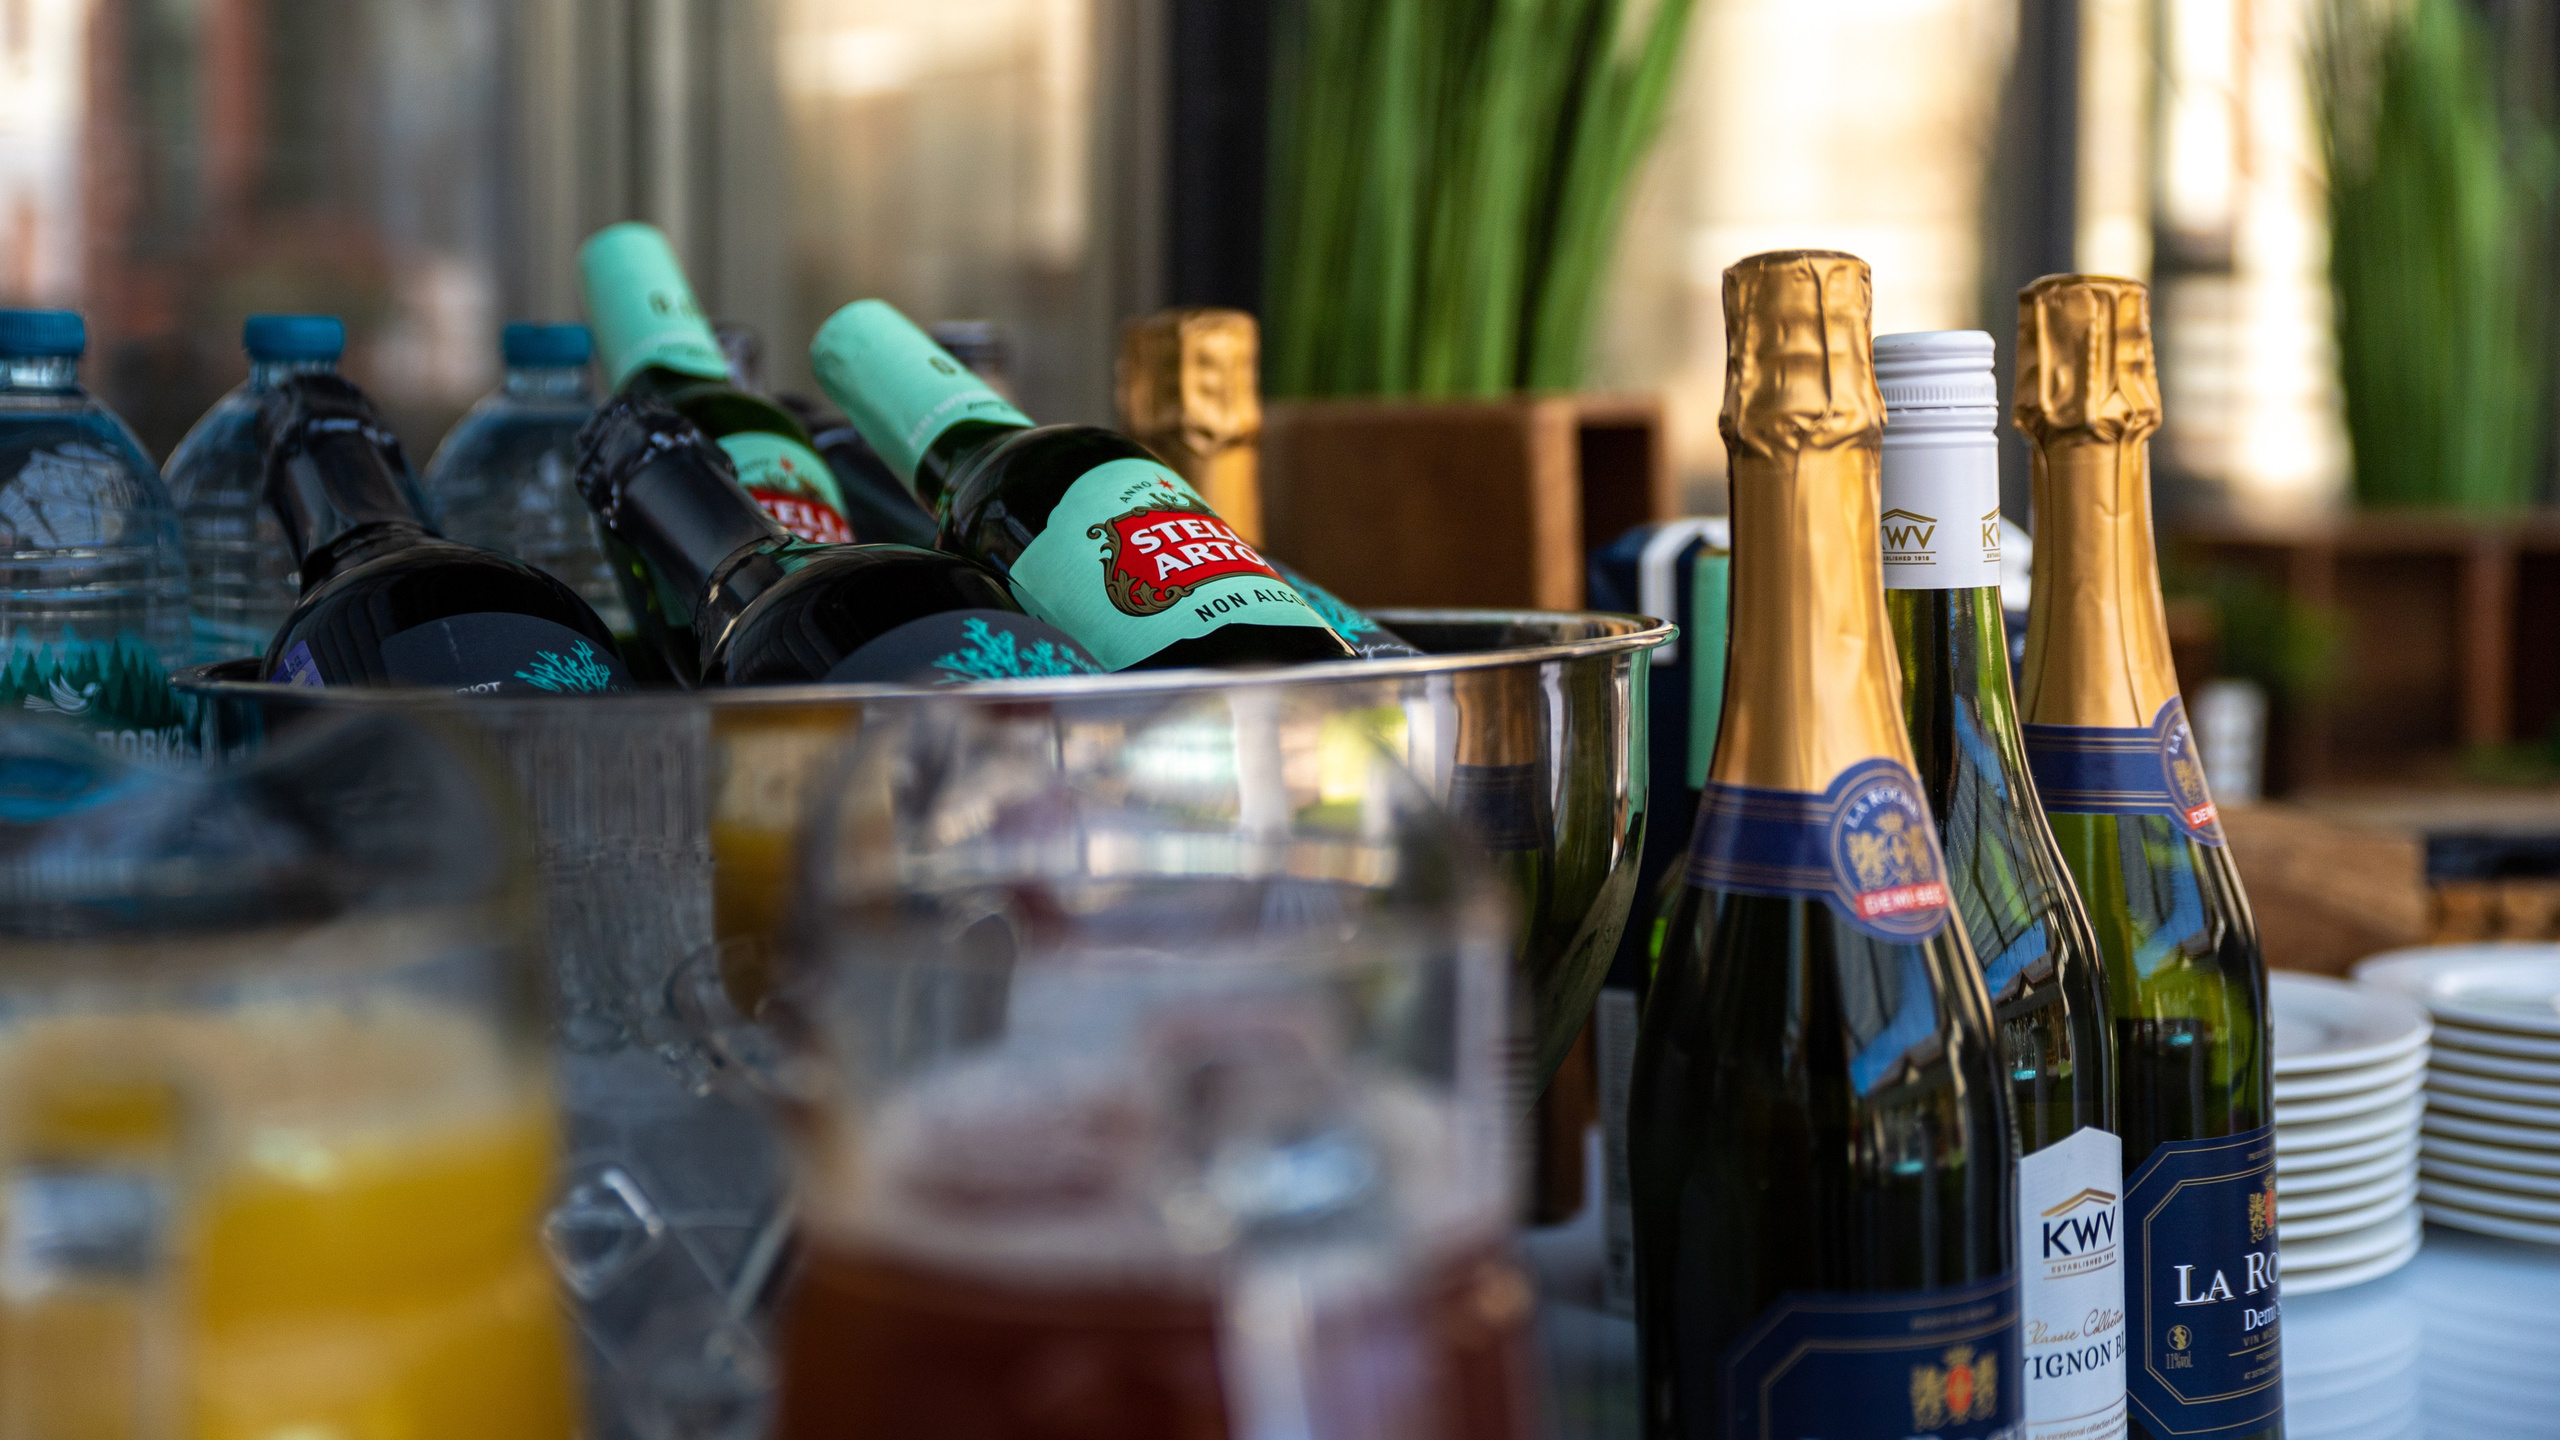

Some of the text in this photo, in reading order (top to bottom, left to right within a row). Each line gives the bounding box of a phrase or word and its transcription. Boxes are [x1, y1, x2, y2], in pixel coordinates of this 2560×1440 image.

[1119, 480, 1152, 504] ANNO
[1194, 592, 1248, 622] NON
[2043, 1205, 2116, 1259] KWV
[2051, 1256, 2103, 1274] ESTABLISHED
[2173, 1264, 2237, 1307] LA
